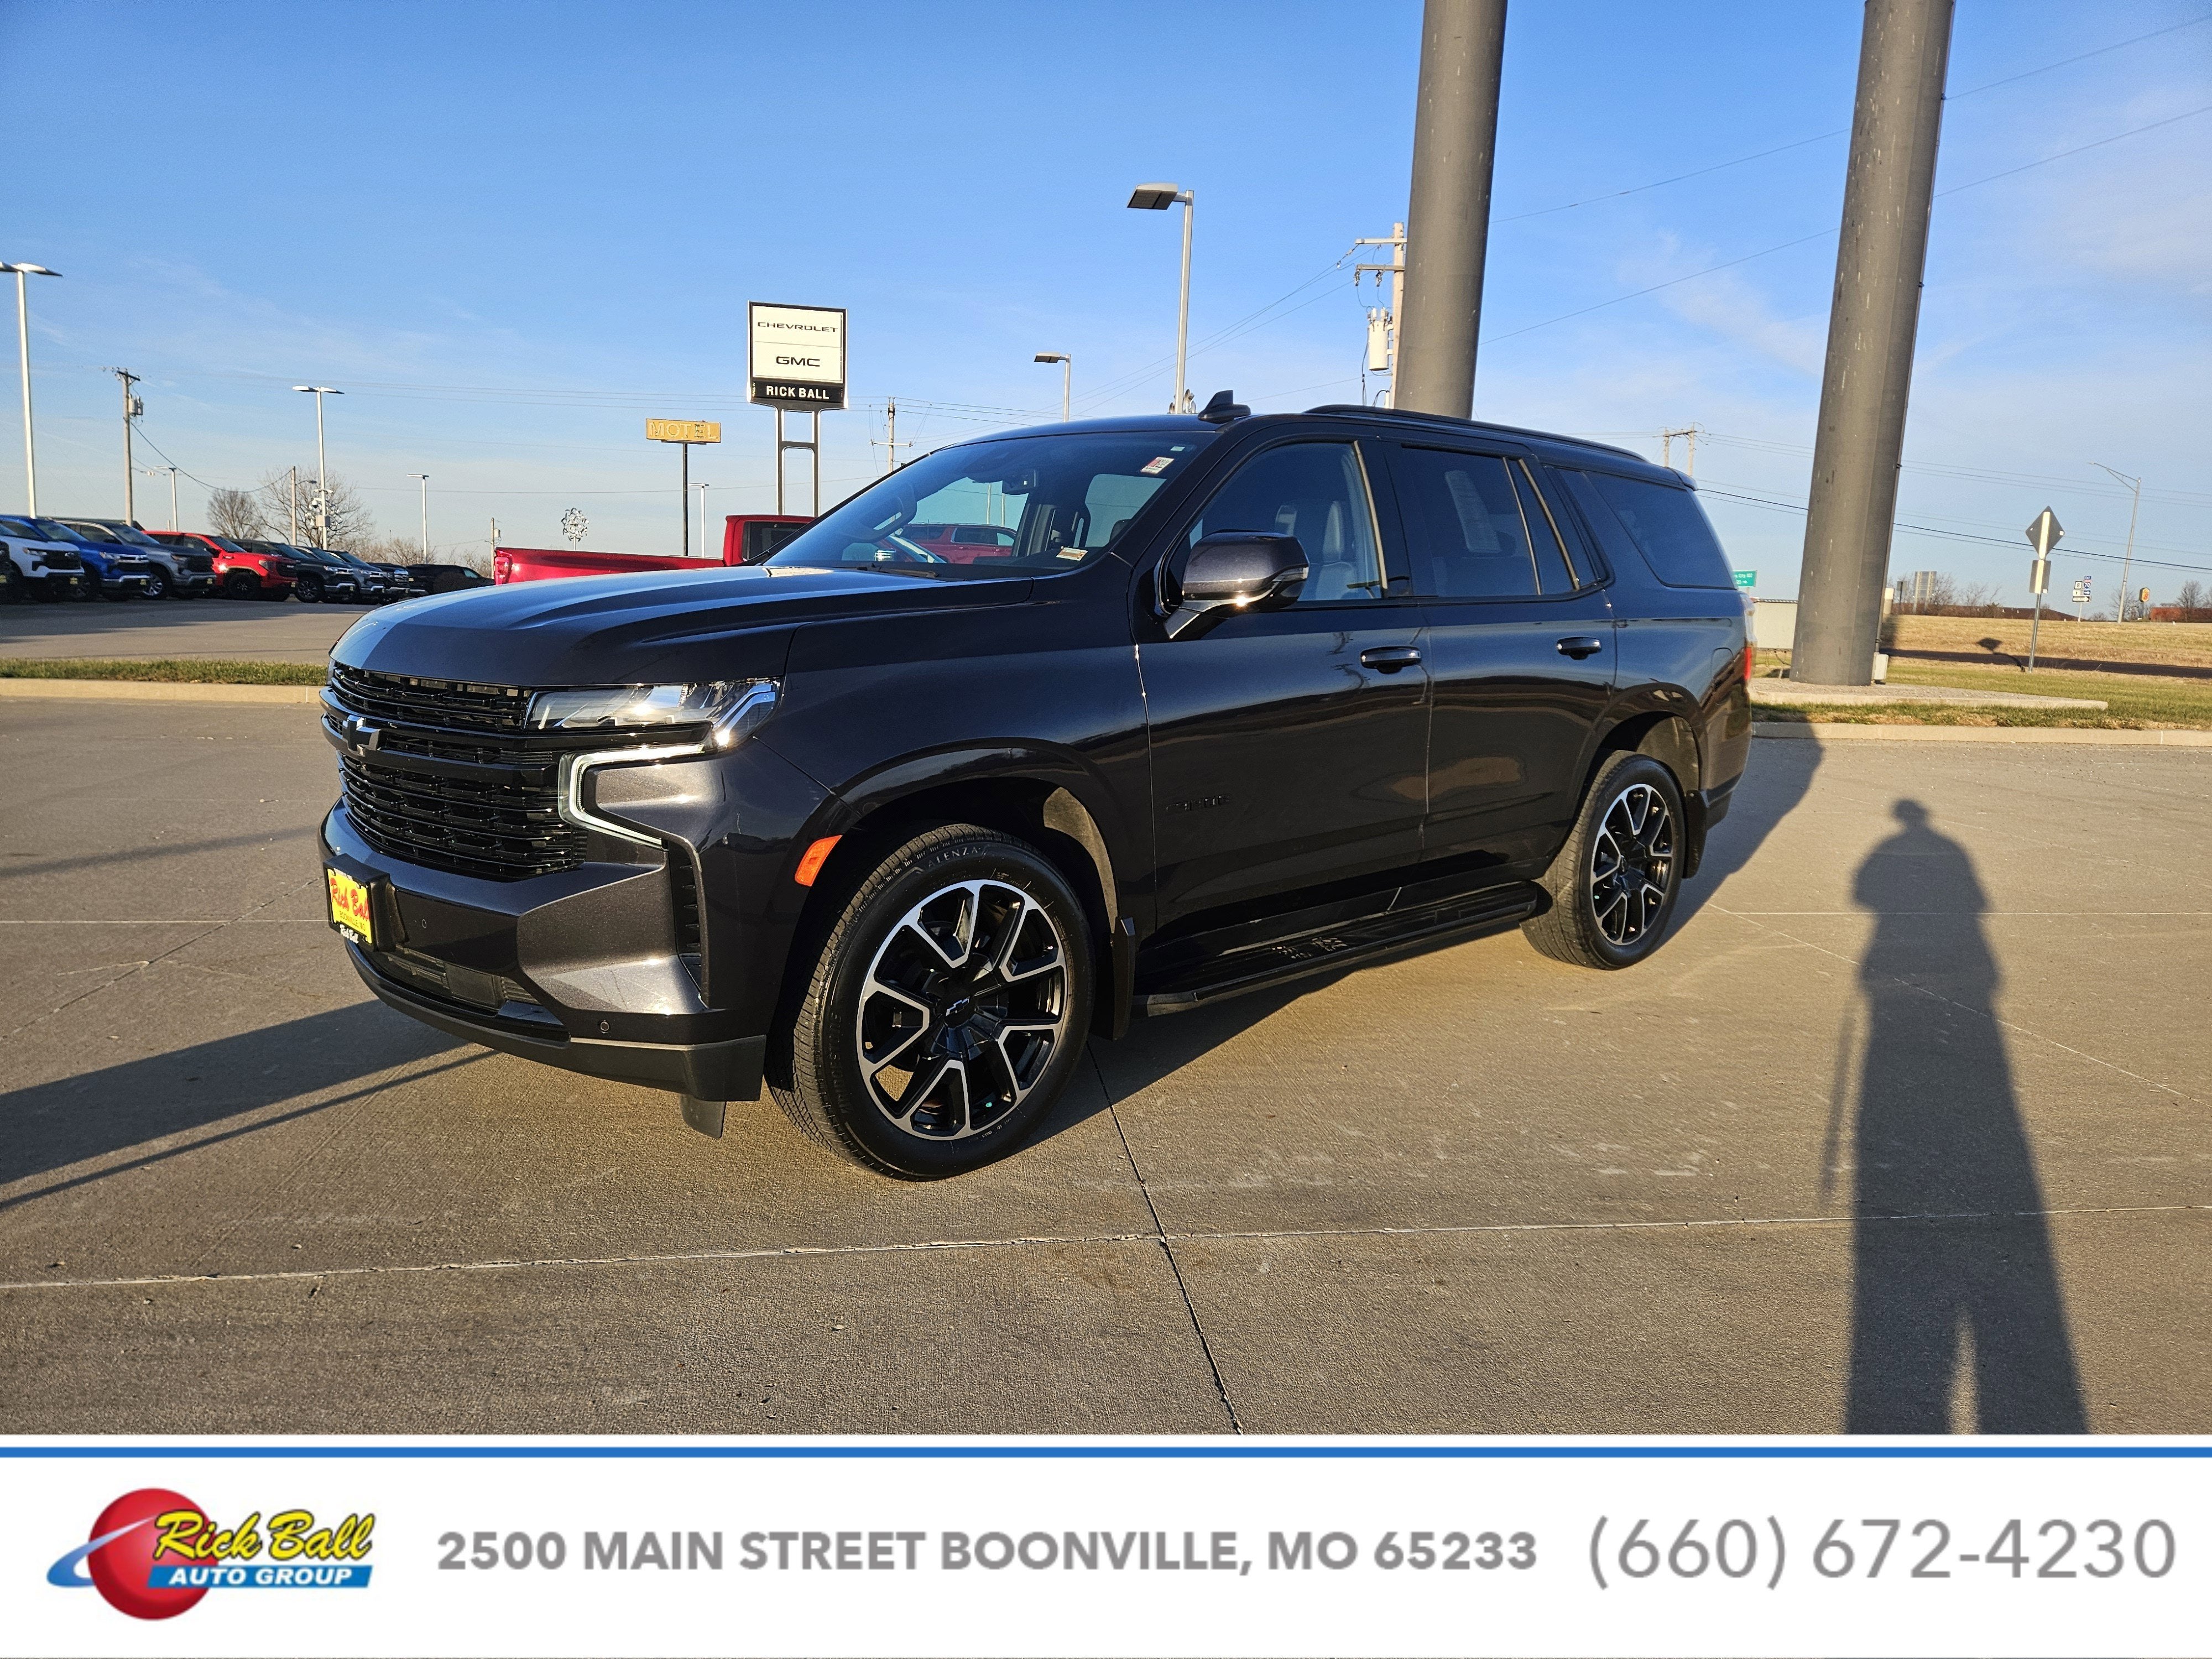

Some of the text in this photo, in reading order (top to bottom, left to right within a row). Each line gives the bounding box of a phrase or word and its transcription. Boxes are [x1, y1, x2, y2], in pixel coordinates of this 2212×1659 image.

[758, 322, 838, 333] CHEVROLET
[776, 356, 820, 367] GMC
[766, 385, 796, 398] RICK
[799, 388, 830, 400] BALL
[650, 421, 718, 439] MOTEL
[928, 846, 978, 868] ALENZA
